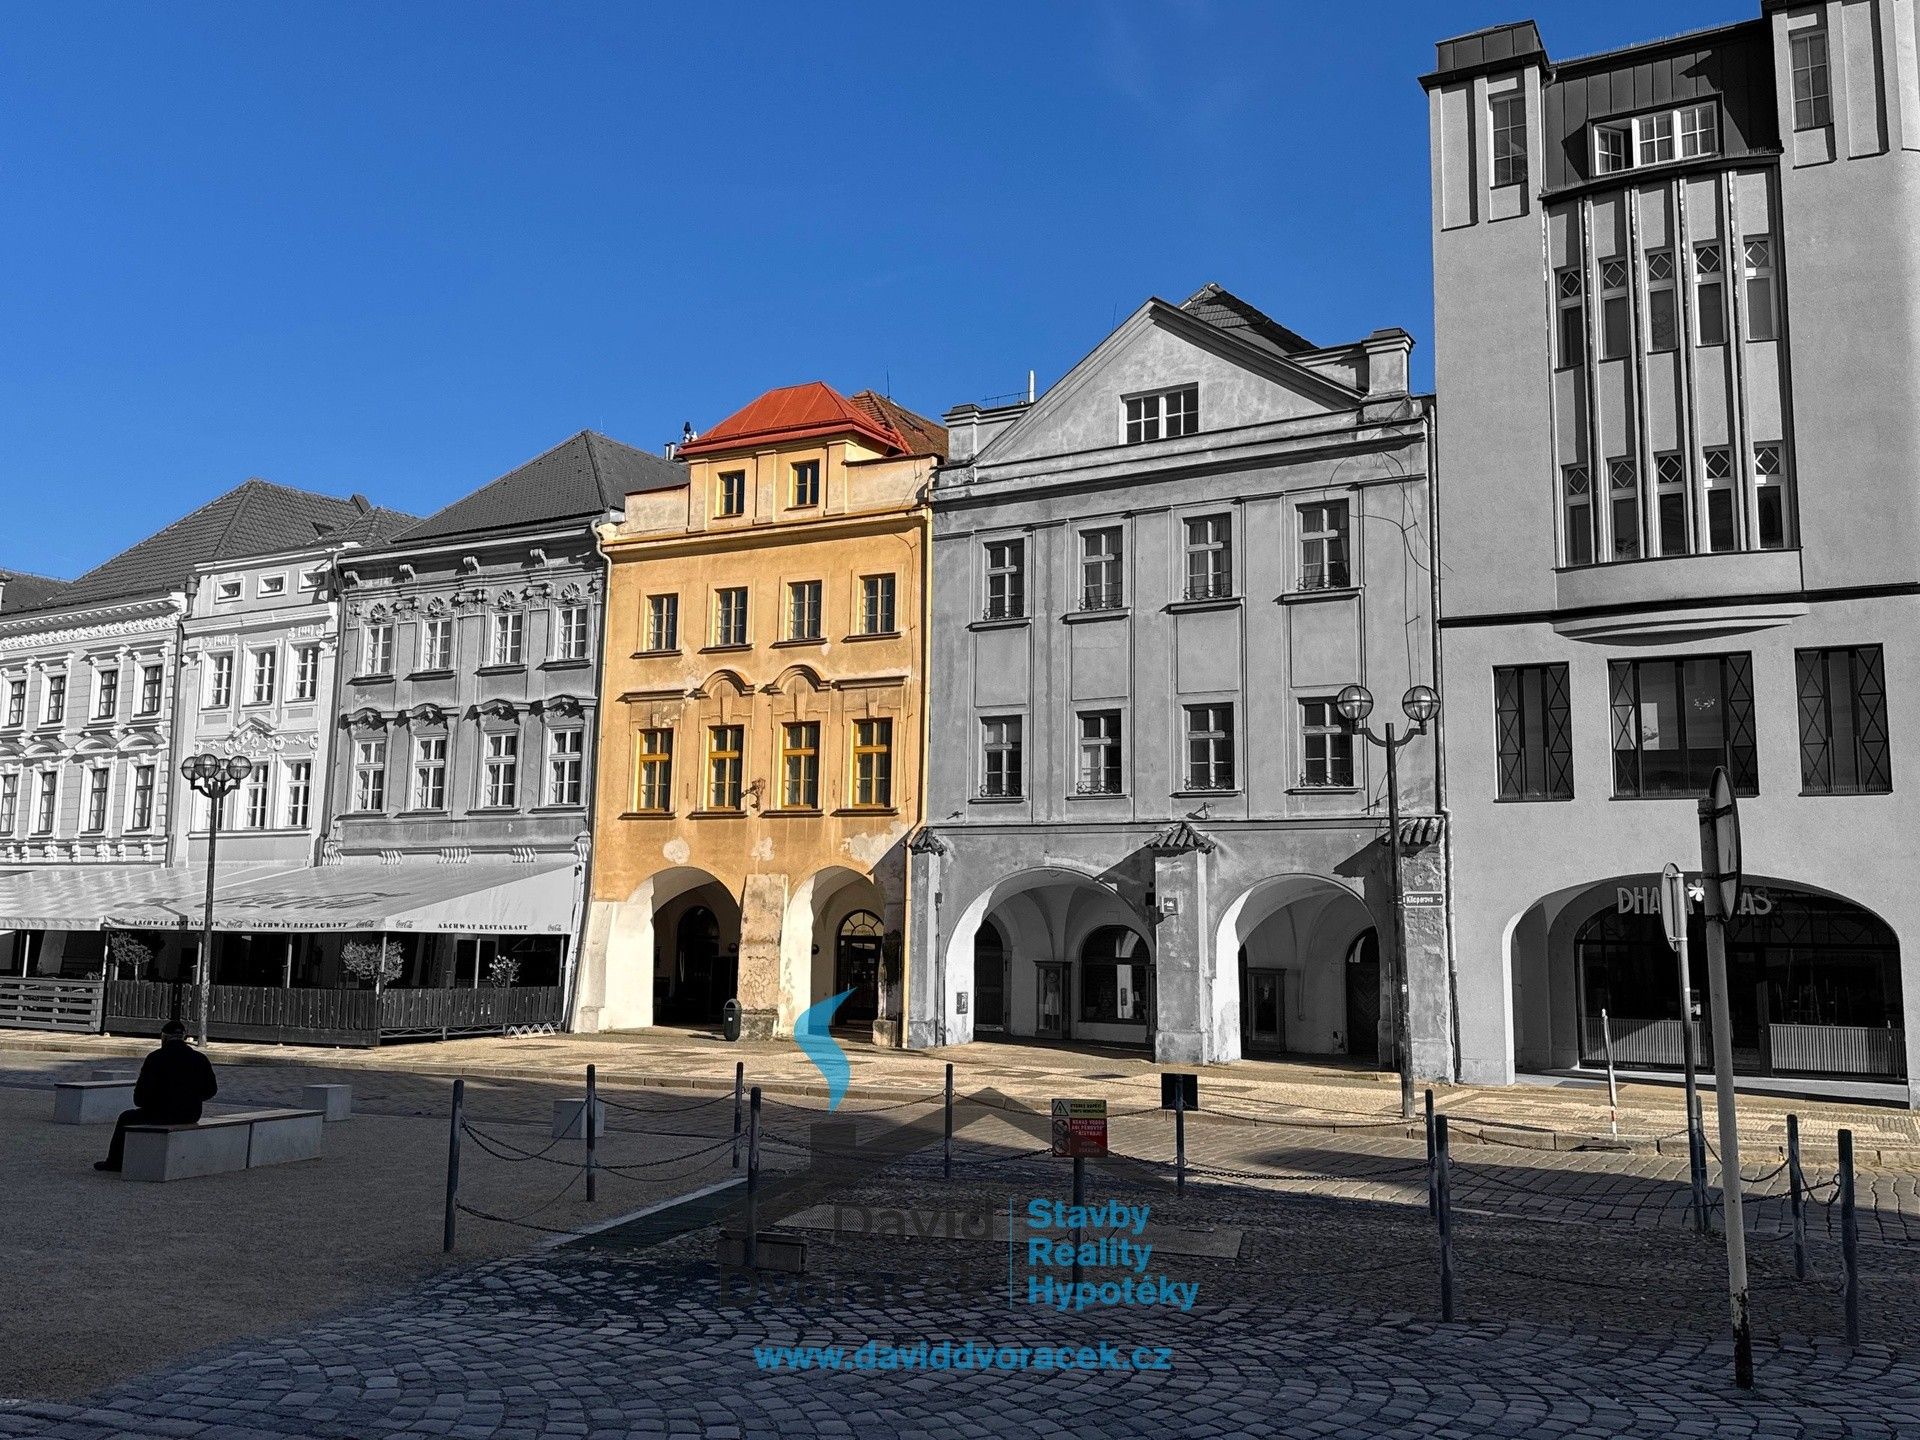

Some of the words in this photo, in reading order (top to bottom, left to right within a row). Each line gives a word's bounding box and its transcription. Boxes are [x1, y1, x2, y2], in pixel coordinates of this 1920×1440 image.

[293, 921, 348, 929] RESTAURANT
[437, 922, 476, 930] ARCHWAY
[479, 923, 528, 931] RESTAURANT
